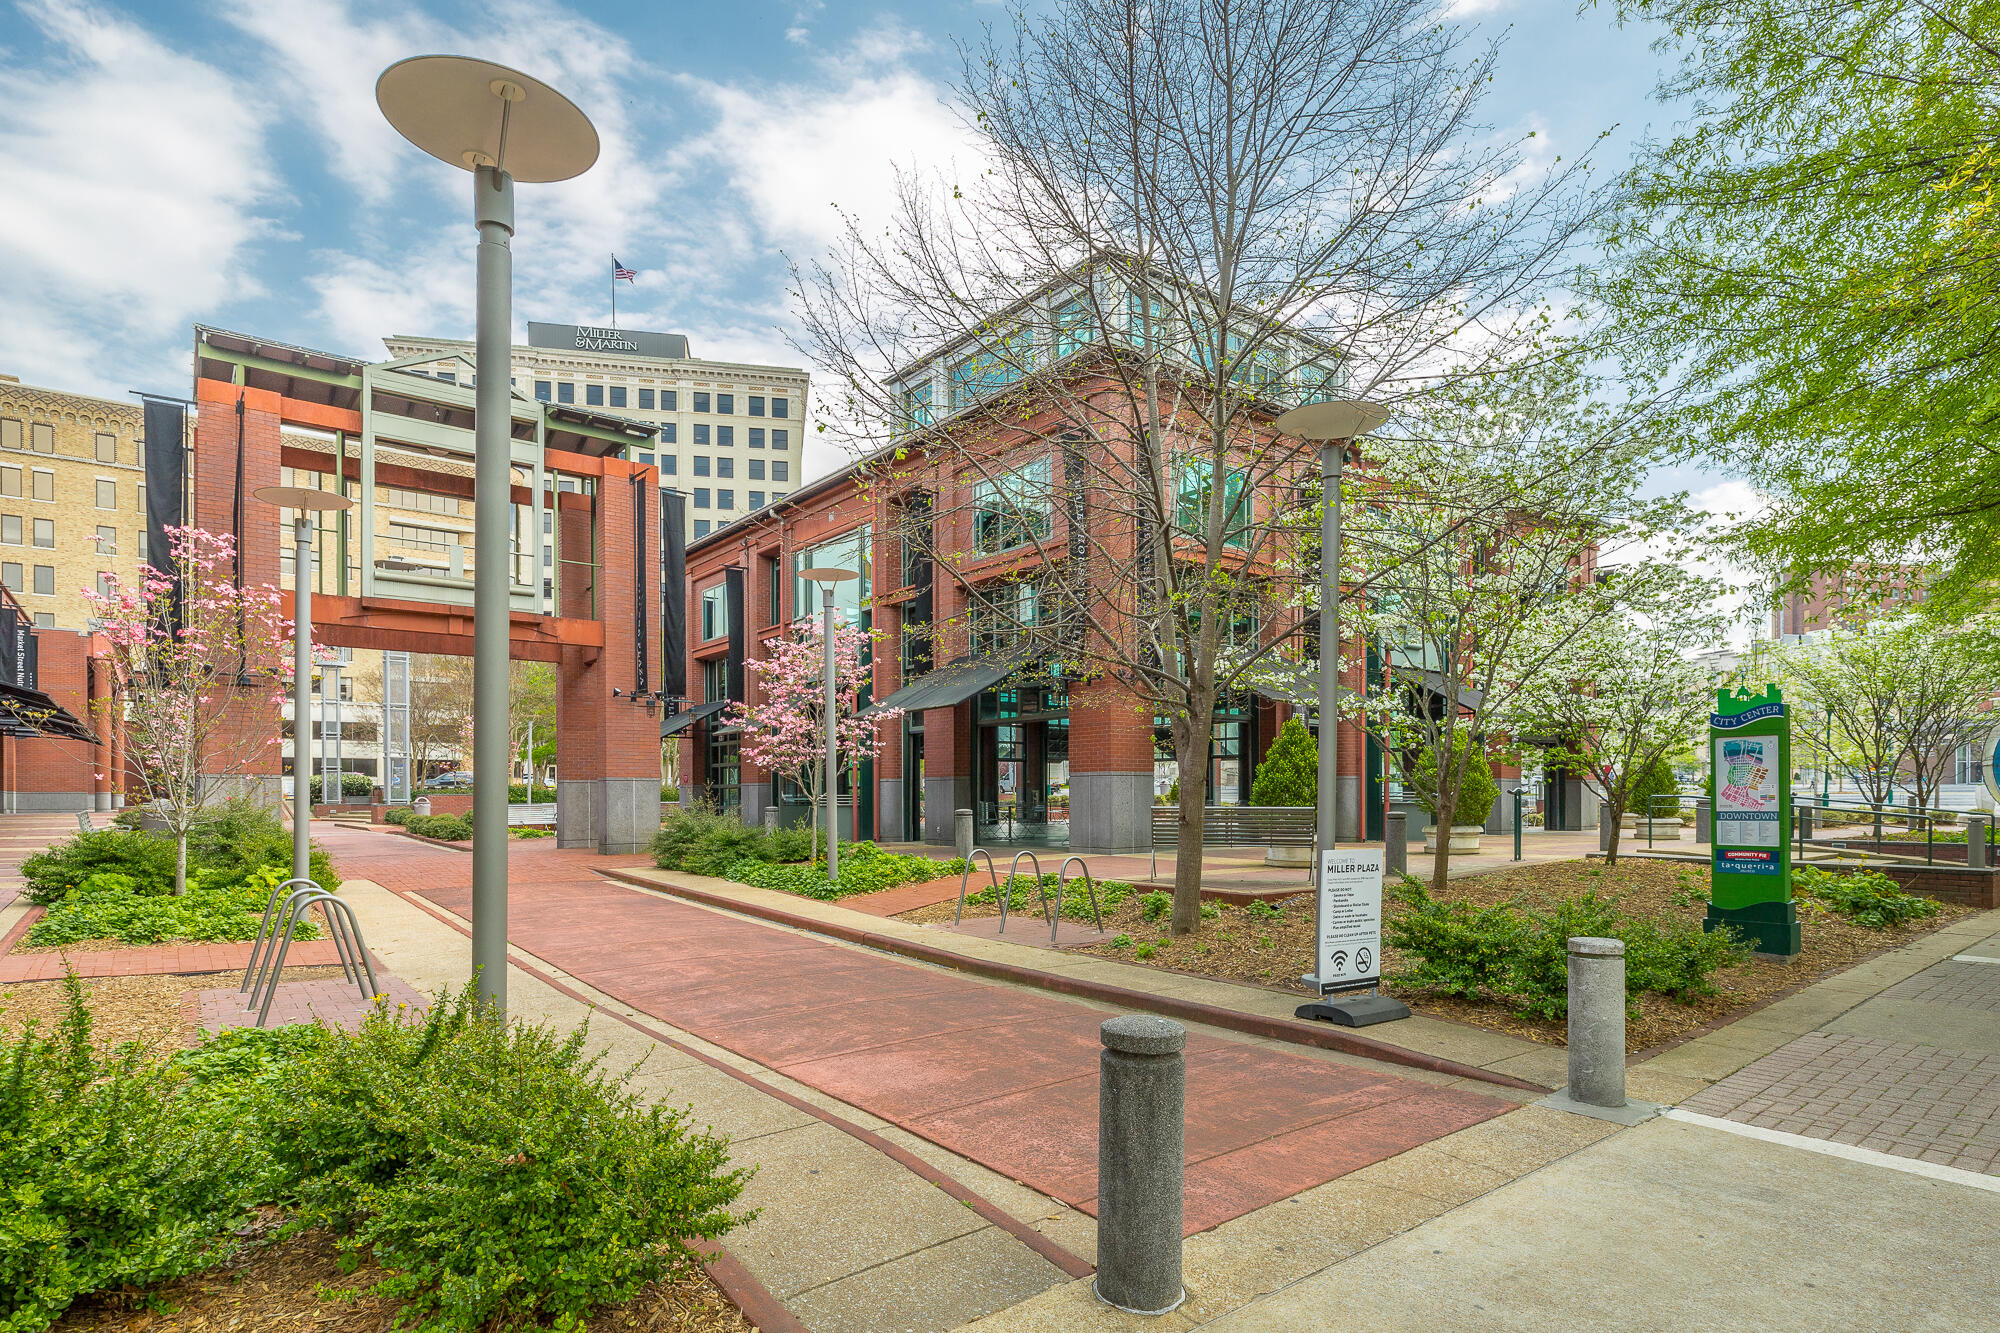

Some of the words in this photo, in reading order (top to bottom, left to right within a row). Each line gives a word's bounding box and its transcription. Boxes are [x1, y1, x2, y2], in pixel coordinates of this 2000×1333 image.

[576, 327, 622, 340] MILLER
[17, 630, 25, 651] Market
[17, 652, 25, 671] Street
[1713, 717, 1737, 725] CITY
[1740, 705, 1779, 721] CENTER
[1720, 812, 1778, 820] DOWNTOWN
[1327, 864, 1355, 873] MILLER
[1357, 863, 1380, 872] PLAZA
